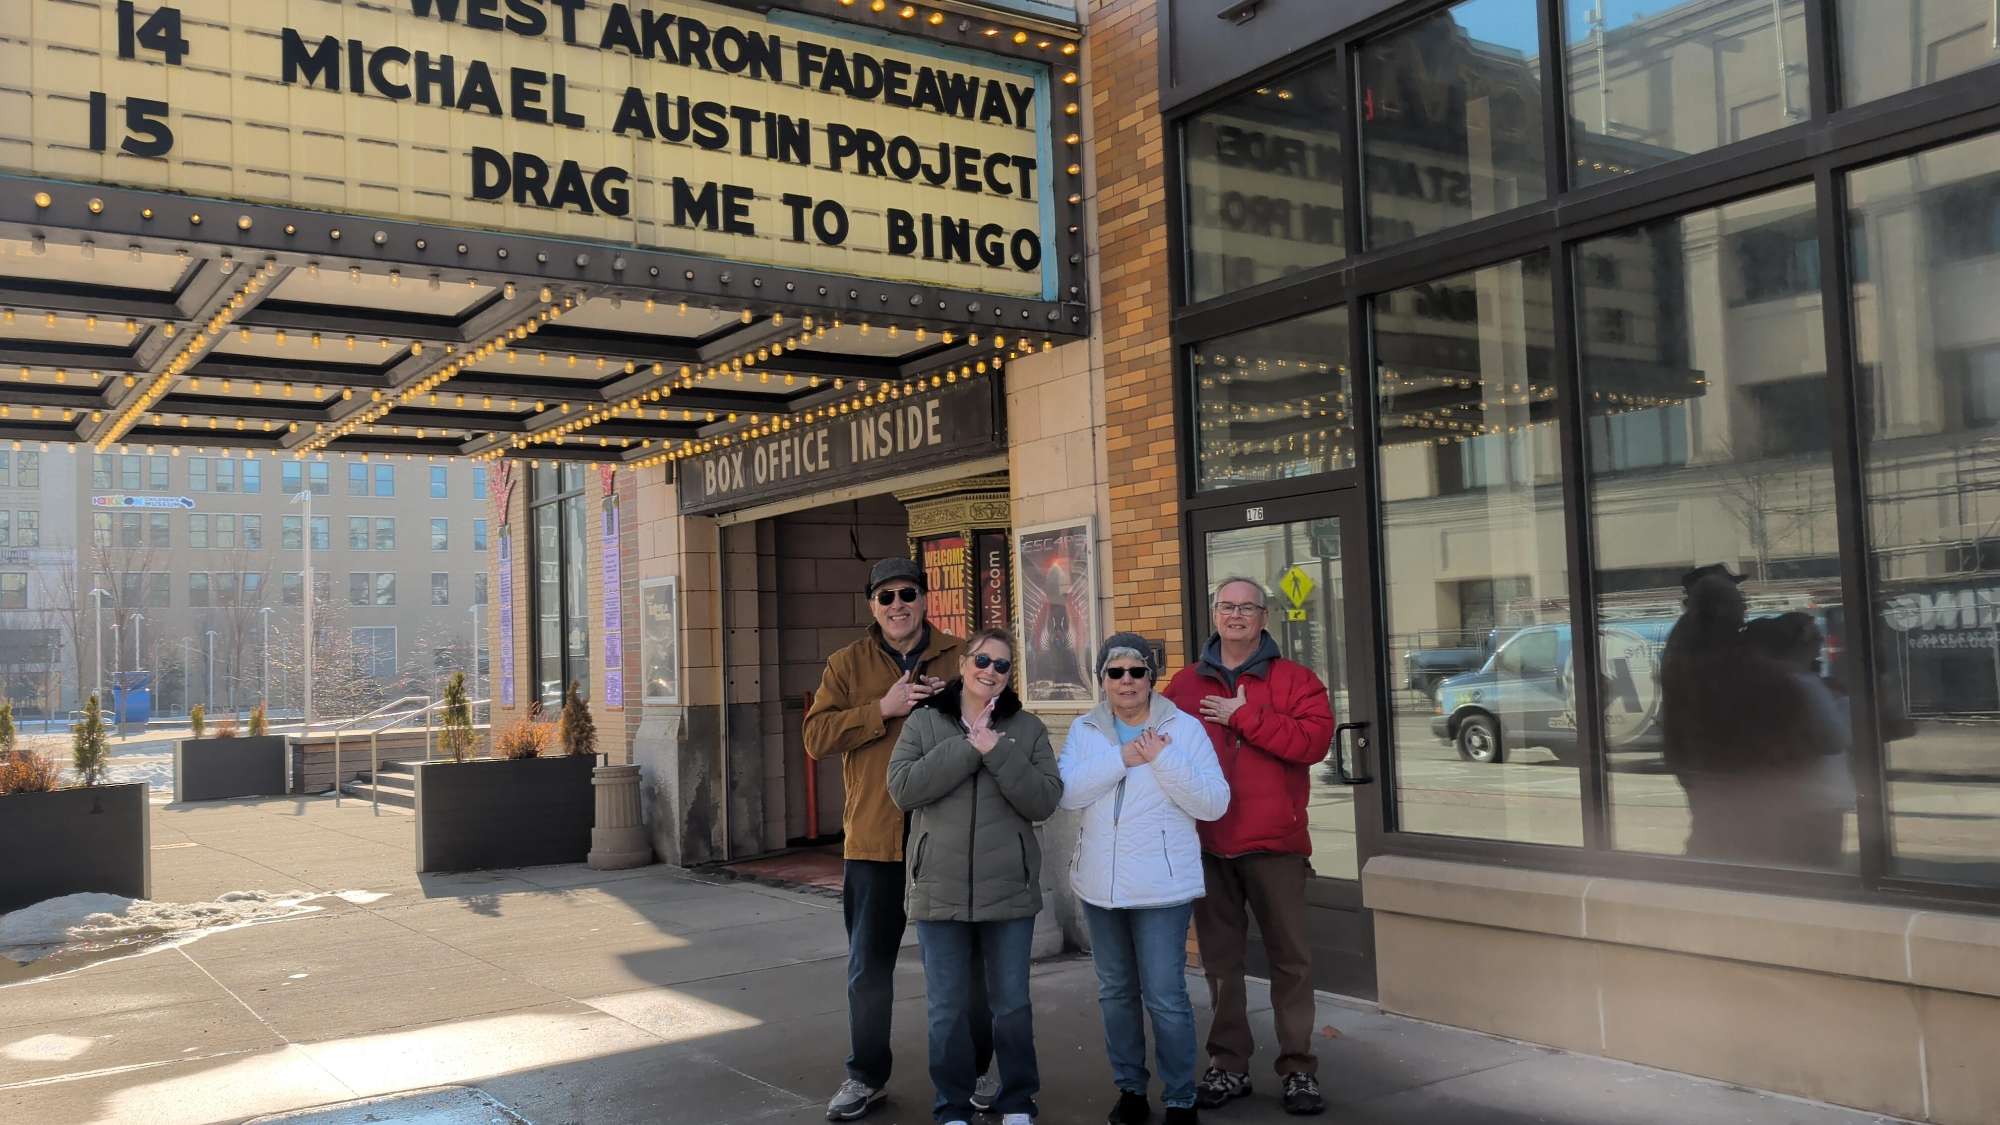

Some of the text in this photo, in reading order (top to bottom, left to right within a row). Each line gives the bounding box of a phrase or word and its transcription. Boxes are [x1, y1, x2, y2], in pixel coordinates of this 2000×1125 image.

[117, 0, 190, 65] 14
[600, 3, 783, 82] AKRON
[798, 41, 1035, 128] FADEAWAY
[89, 91, 174, 157] 15
[281, 27, 1037, 199] MICHAEL AUSTIN PROJECT
[471, 146, 1042, 271] DRAG ME TO BINGO
[704, 399, 942, 496] BOX OFFICE INSIDE
[1247, 508, 1263, 521] 176
[925, 548, 965, 568] WELCOME
[926, 565, 965, 591] TO THE
[985, 550, 1002, 628] ivic.com
